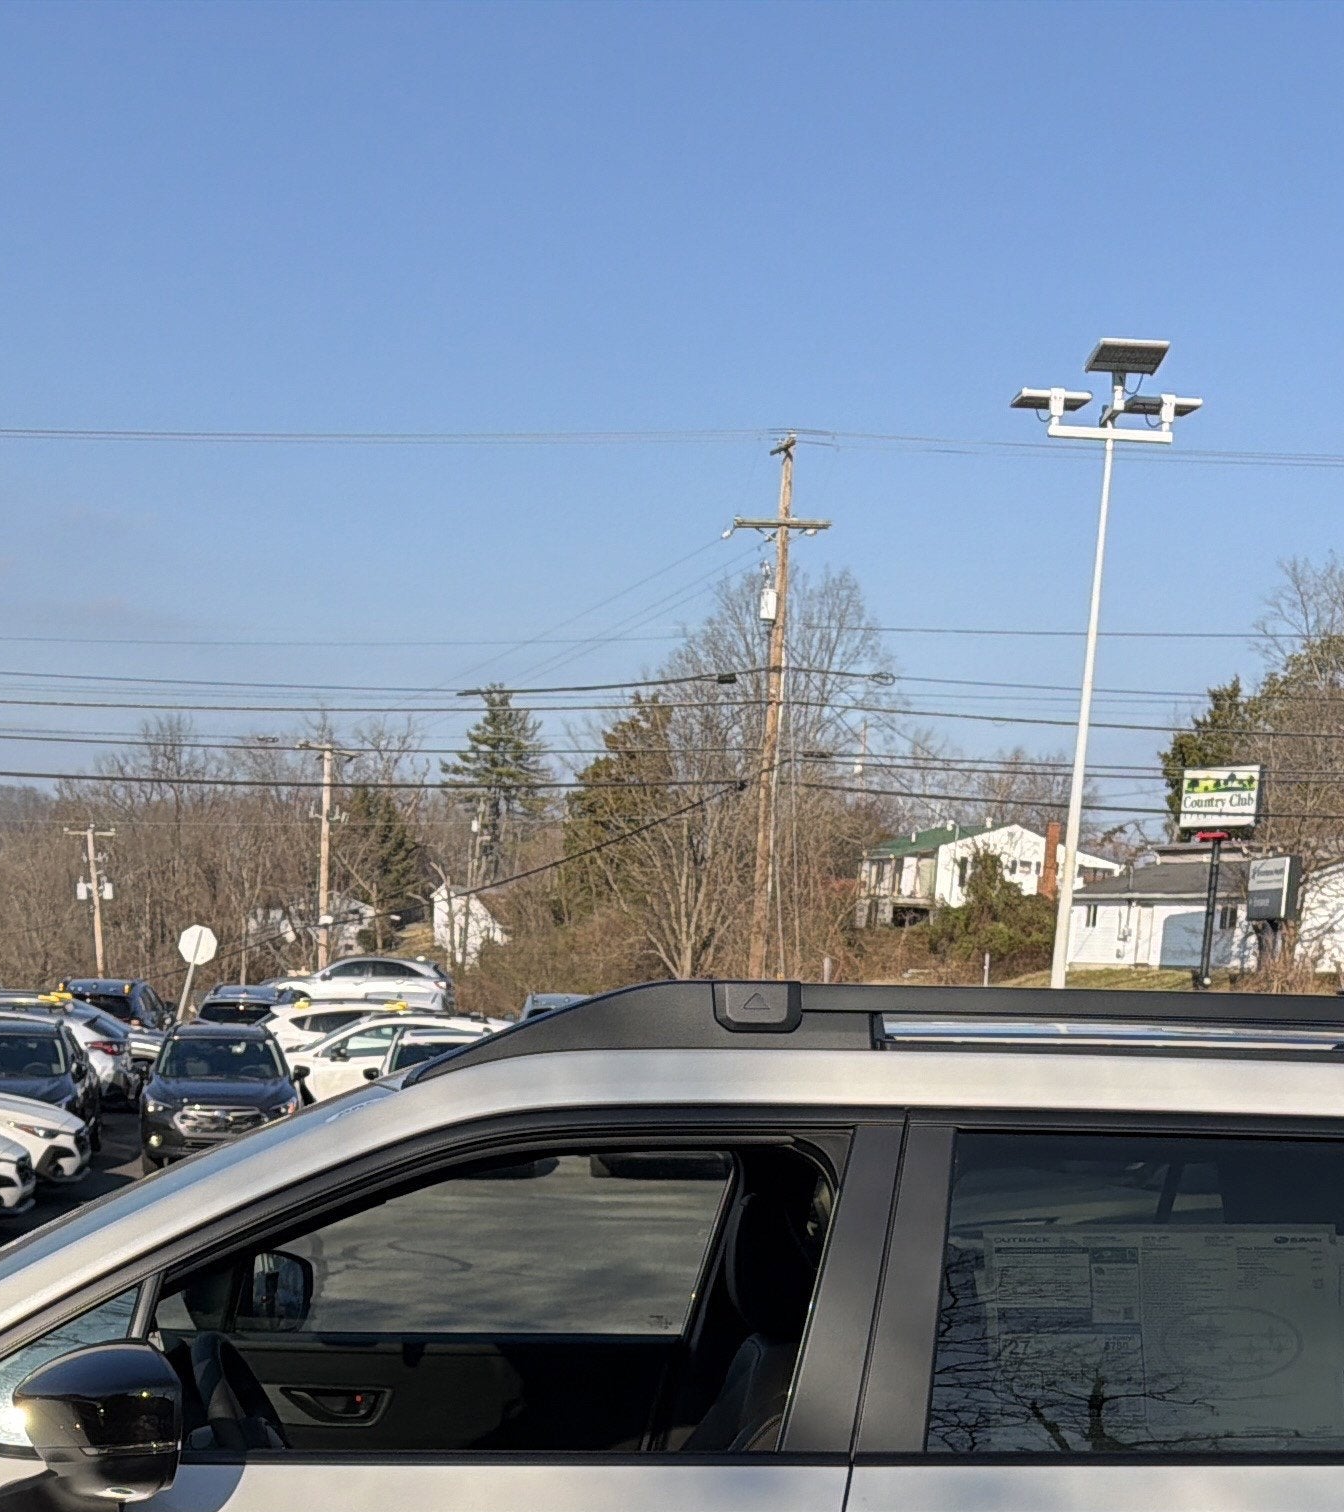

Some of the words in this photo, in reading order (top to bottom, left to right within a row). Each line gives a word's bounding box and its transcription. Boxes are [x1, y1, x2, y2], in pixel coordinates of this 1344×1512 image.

[1183, 796, 1227, 809] Country
[1229, 792, 1255, 808] Club
[993, 1236, 1051, 1244] OUTBACK
